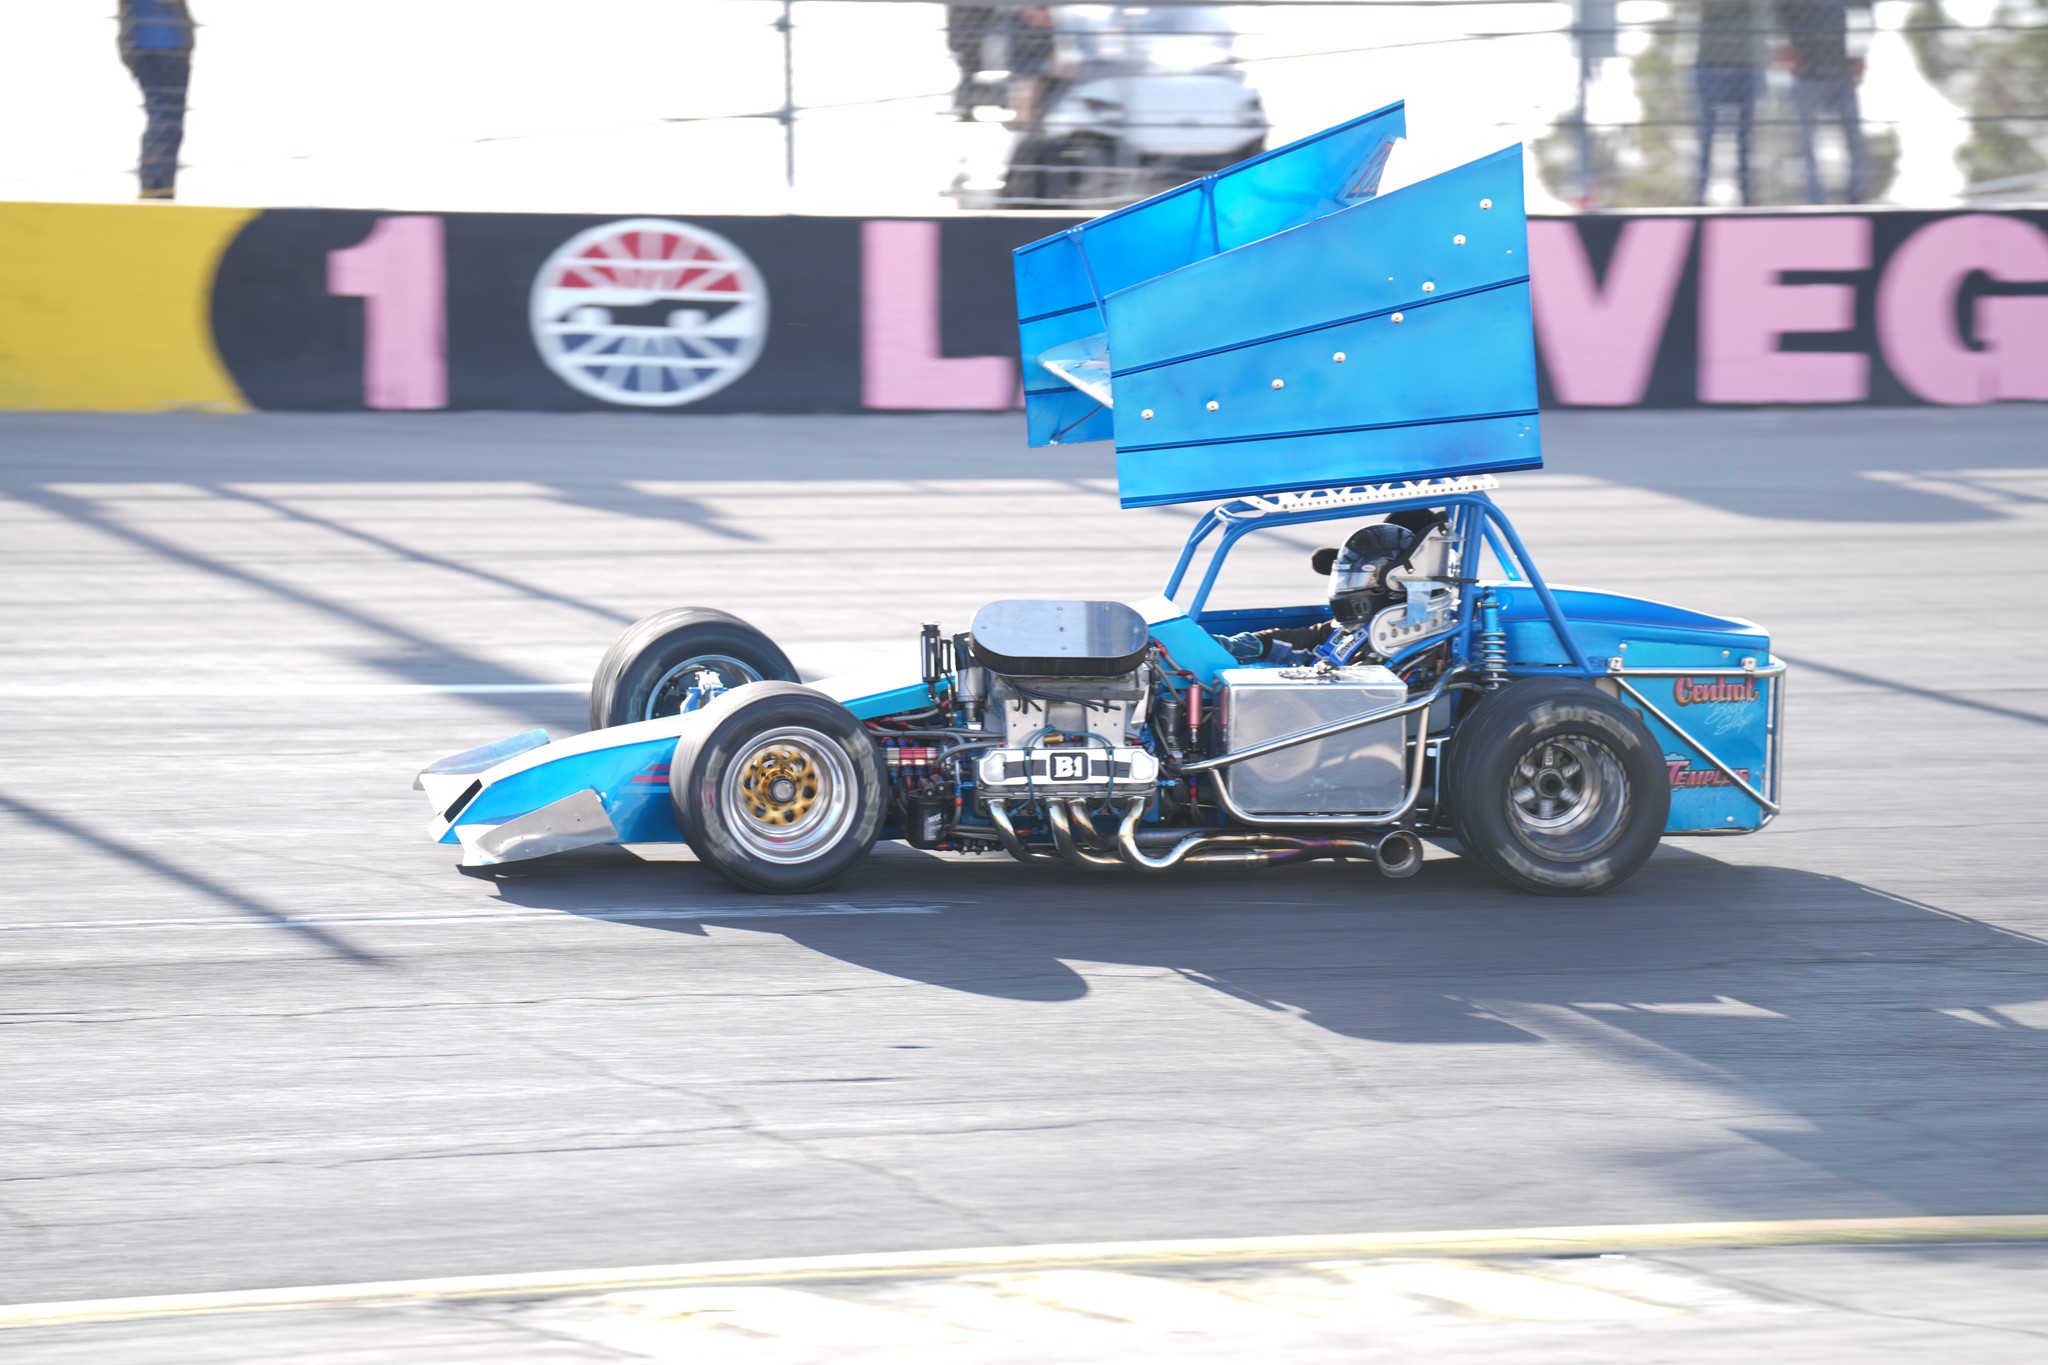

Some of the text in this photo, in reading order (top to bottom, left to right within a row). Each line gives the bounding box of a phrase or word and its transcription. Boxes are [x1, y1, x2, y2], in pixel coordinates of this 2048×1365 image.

[327, 215, 449, 409] 1
[1673, 676, 1759, 706] Central
[1053, 756, 1083, 778] B1
